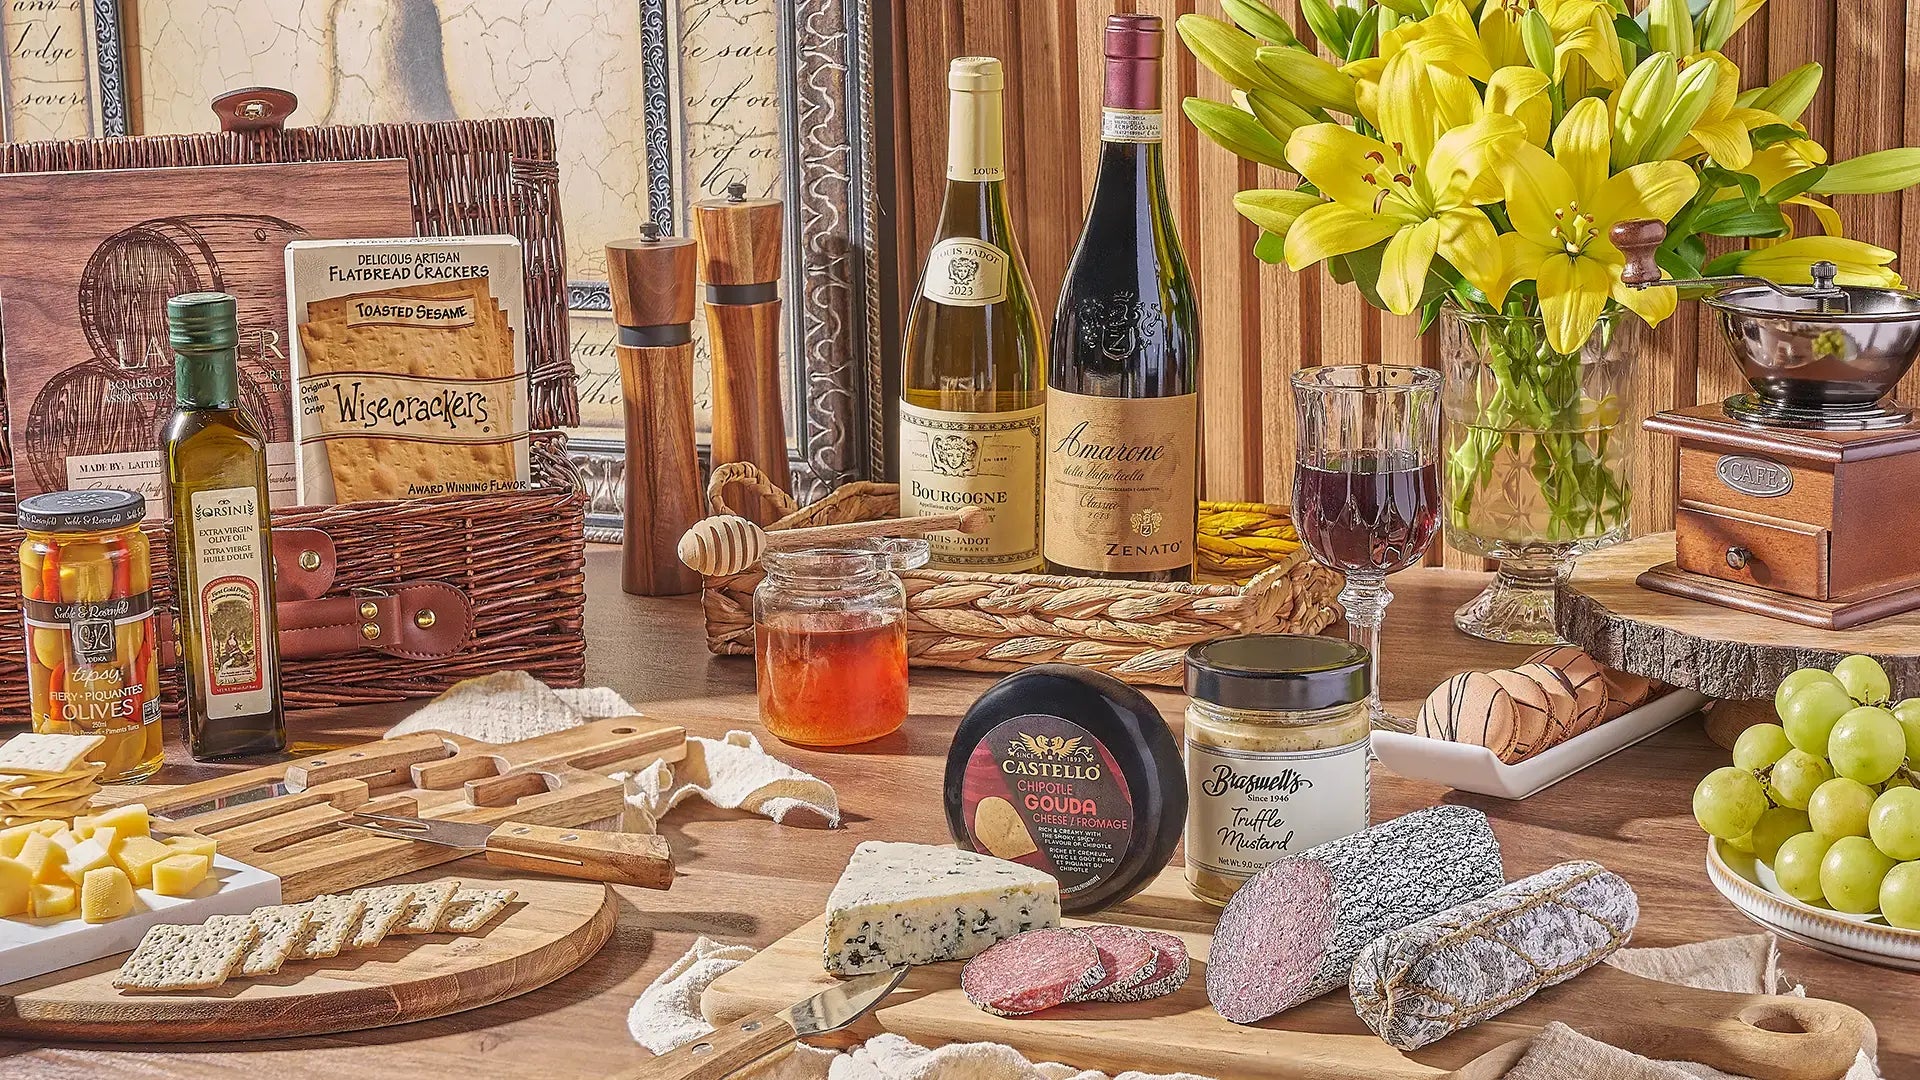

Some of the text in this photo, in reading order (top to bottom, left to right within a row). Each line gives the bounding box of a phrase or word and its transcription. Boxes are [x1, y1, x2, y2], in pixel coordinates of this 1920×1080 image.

[973, 167, 999, 175] LOUIS
[358, 251, 460, 266] DELICIOUS ARTISAN
[936, 246, 1000, 264] LOUIS JADOT
[329, 264, 489, 282] FLATBREAD CRACKERS
[948, 285, 974, 296] 2023
[355, 303, 467, 320] TOASTED SESAME
[108, 377, 173, 390] BOURBON
[301, 380, 331, 395] Original
[302, 394, 319, 404] Thin
[333, 382, 488, 429] Wisecrackers
[304, 404, 325, 416] Crisp
[1054, 421, 1164, 462] Amarone
[79, 464, 107, 473] MADE
[1064, 462, 1144, 485] della Valpolicella
[1730, 462, 1779, 488] CAFE
[408, 480, 526, 495] AWARD WINNING FLAVOR
[1080, 492, 1120, 509] Classico
[199, 525, 253, 537] EXTRA VIRGIN
[208, 534, 247, 544] OLIVE OIL
[922, 534, 990, 545] LOUIS JADOT
[203, 544, 252, 556] EXTRA VIERGE
[203, 552, 254, 564] HUILE D'OLIVE
[78, 603, 88, 617] &
[50, 684, 143, 702] FIERY PIQUANTES
[62, 699, 134, 720] OLIVES
[1002, 759, 1100, 781] CASTELLO
[1017, 779, 1073, 796] CHIPOTLE
[1024, 794, 1097, 816] GOUDA
[1247, 794, 1268, 802] Since
[1033, 812, 1068, 826] CHEESE
[1077, 817, 1128, 830] FROMAGE
[1231, 807, 1285, 833] Truffle
[1058, 828, 1083, 836] CREAMY
[1217, 827, 1294, 852] Mustard
[1044, 838, 1072, 846] FLAVOUR
[1083, 842, 1112, 850] CHIPOTLE
[1059, 865, 1089, 874] CHIPOTLE
[1218, 857, 1229, 865] Net
[1230, 859, 1241, 867] Wt.
[1242, 861, 1253, 869] 9.0
